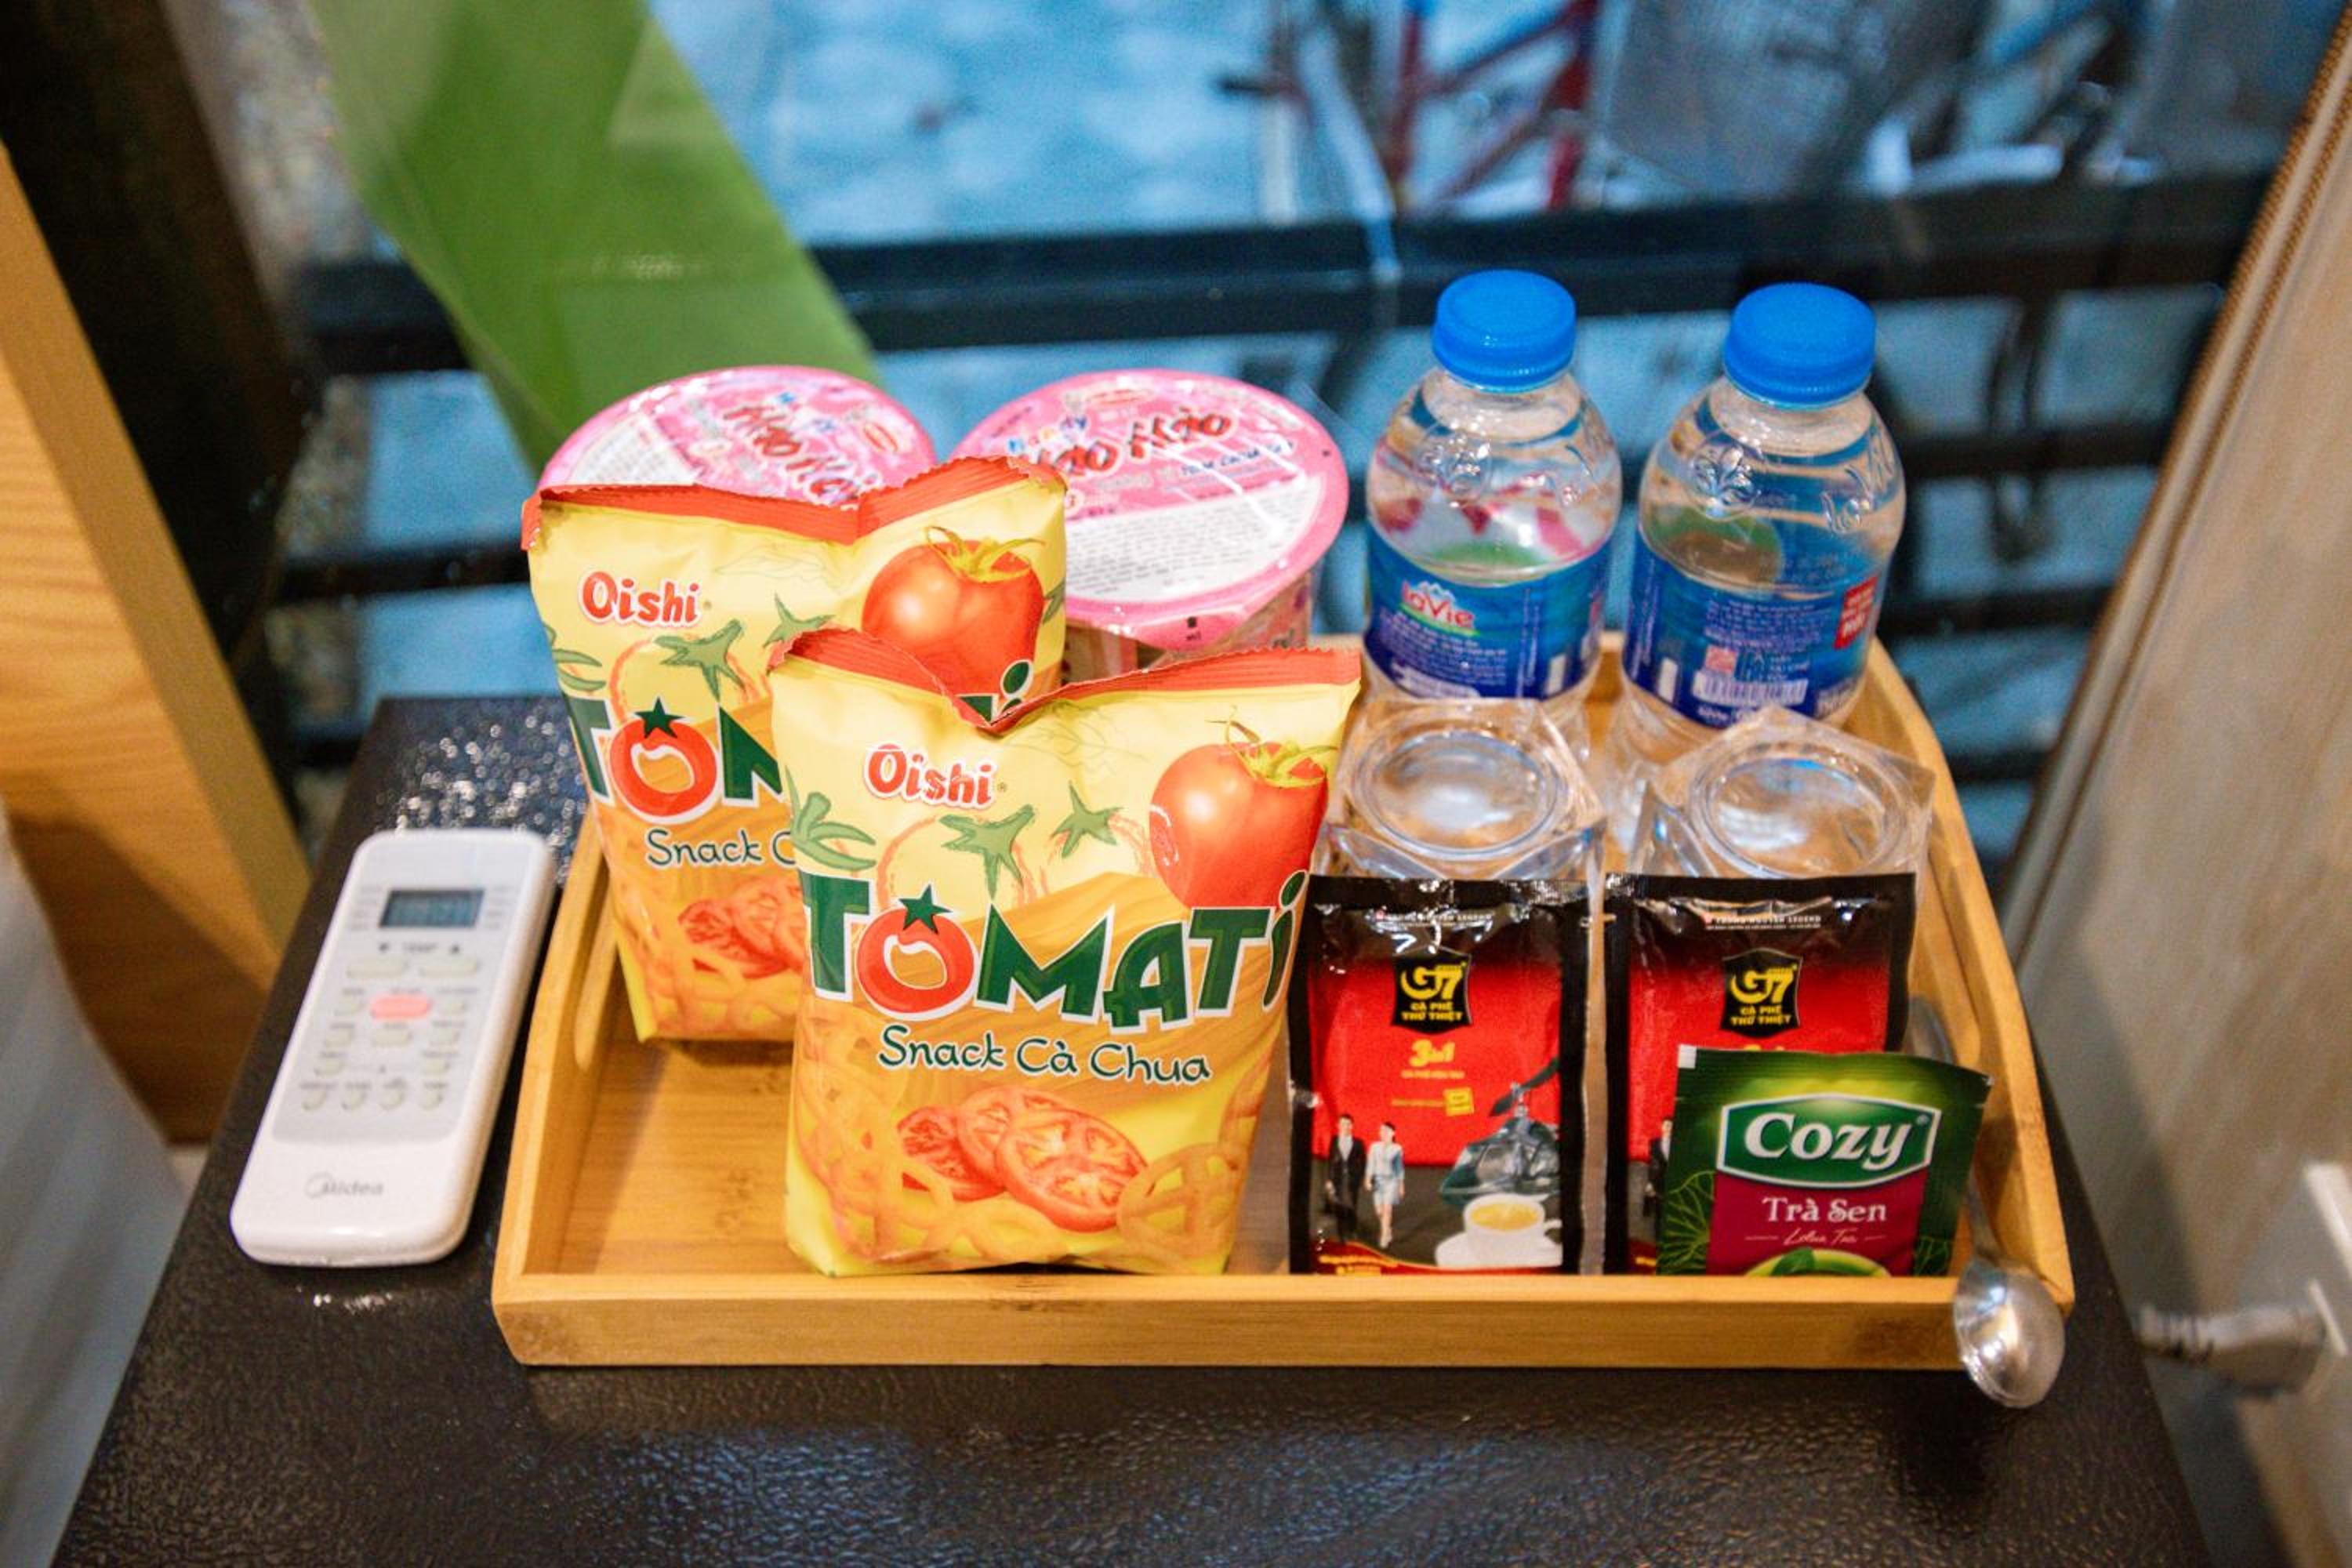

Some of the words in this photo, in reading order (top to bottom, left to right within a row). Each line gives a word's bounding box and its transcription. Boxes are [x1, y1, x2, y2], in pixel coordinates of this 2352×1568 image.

[582, 571, 700, 624] Oishi
[867, 743, 995, 805] Oishi
[648, 828, 762, 866] Snack
[772, 830, 797, 865] C
[1400, 964, 1464, 1000] G7
[1731, 967, 1794, 1004] G7
[879, 1025, 1005, 1069] Snack
[1017, 1036, 1077, 1074] Cà
[1091, 1043, 1210, 1083] Chua
[1744, 1112, 1912, 1171] Cozy
[1762, 1196, 1820, 1222] Trà
[1828, 1199, 1887, 1222] Sen
